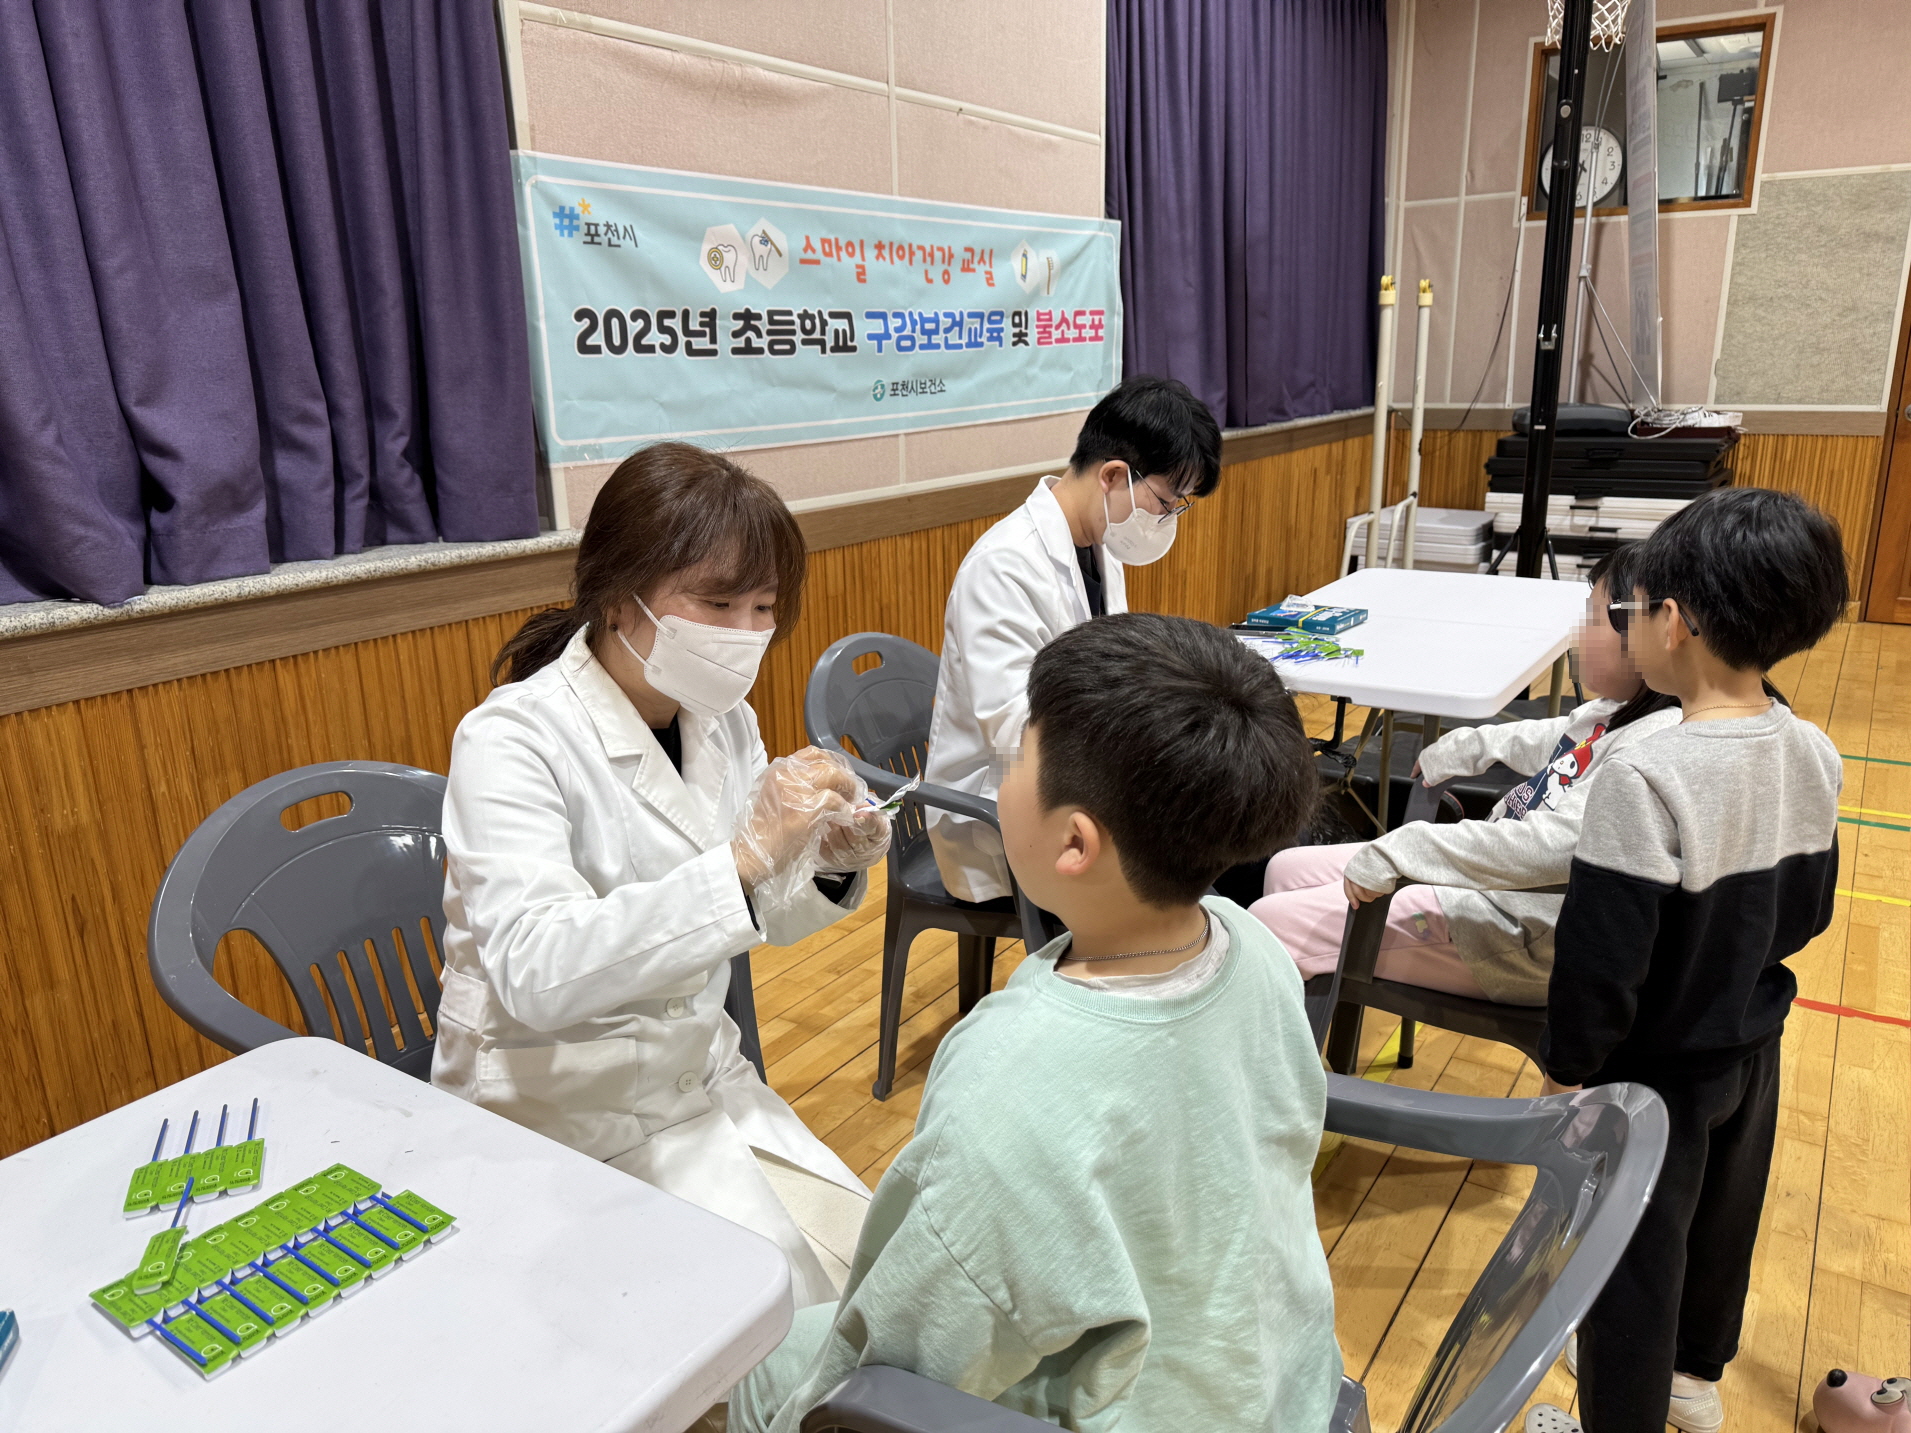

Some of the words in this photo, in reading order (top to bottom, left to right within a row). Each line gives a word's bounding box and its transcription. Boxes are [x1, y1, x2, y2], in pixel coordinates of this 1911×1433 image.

[1607, 147, 1614, 157] 2
[1609, 161, 1616, 171] 3
[1601, 177, 1608, 185] 4
[582, 220, 639, 249] 포천시
[799, 234, 867, 284] 스마일
[873, 239, 955, 286] 치아건강
[960, 246, 996, 288] 교실
[572, 306, 720, 359] 2025년
[729, 306, 858, 357] 초등학교
[864, 308, 1006, 355] 구강보건교육
[1010, 308, 1030, 348] 및
[1034, 308, 1106, 347] 불소도포
[888, 378, 947, 398] 포천시보건소
